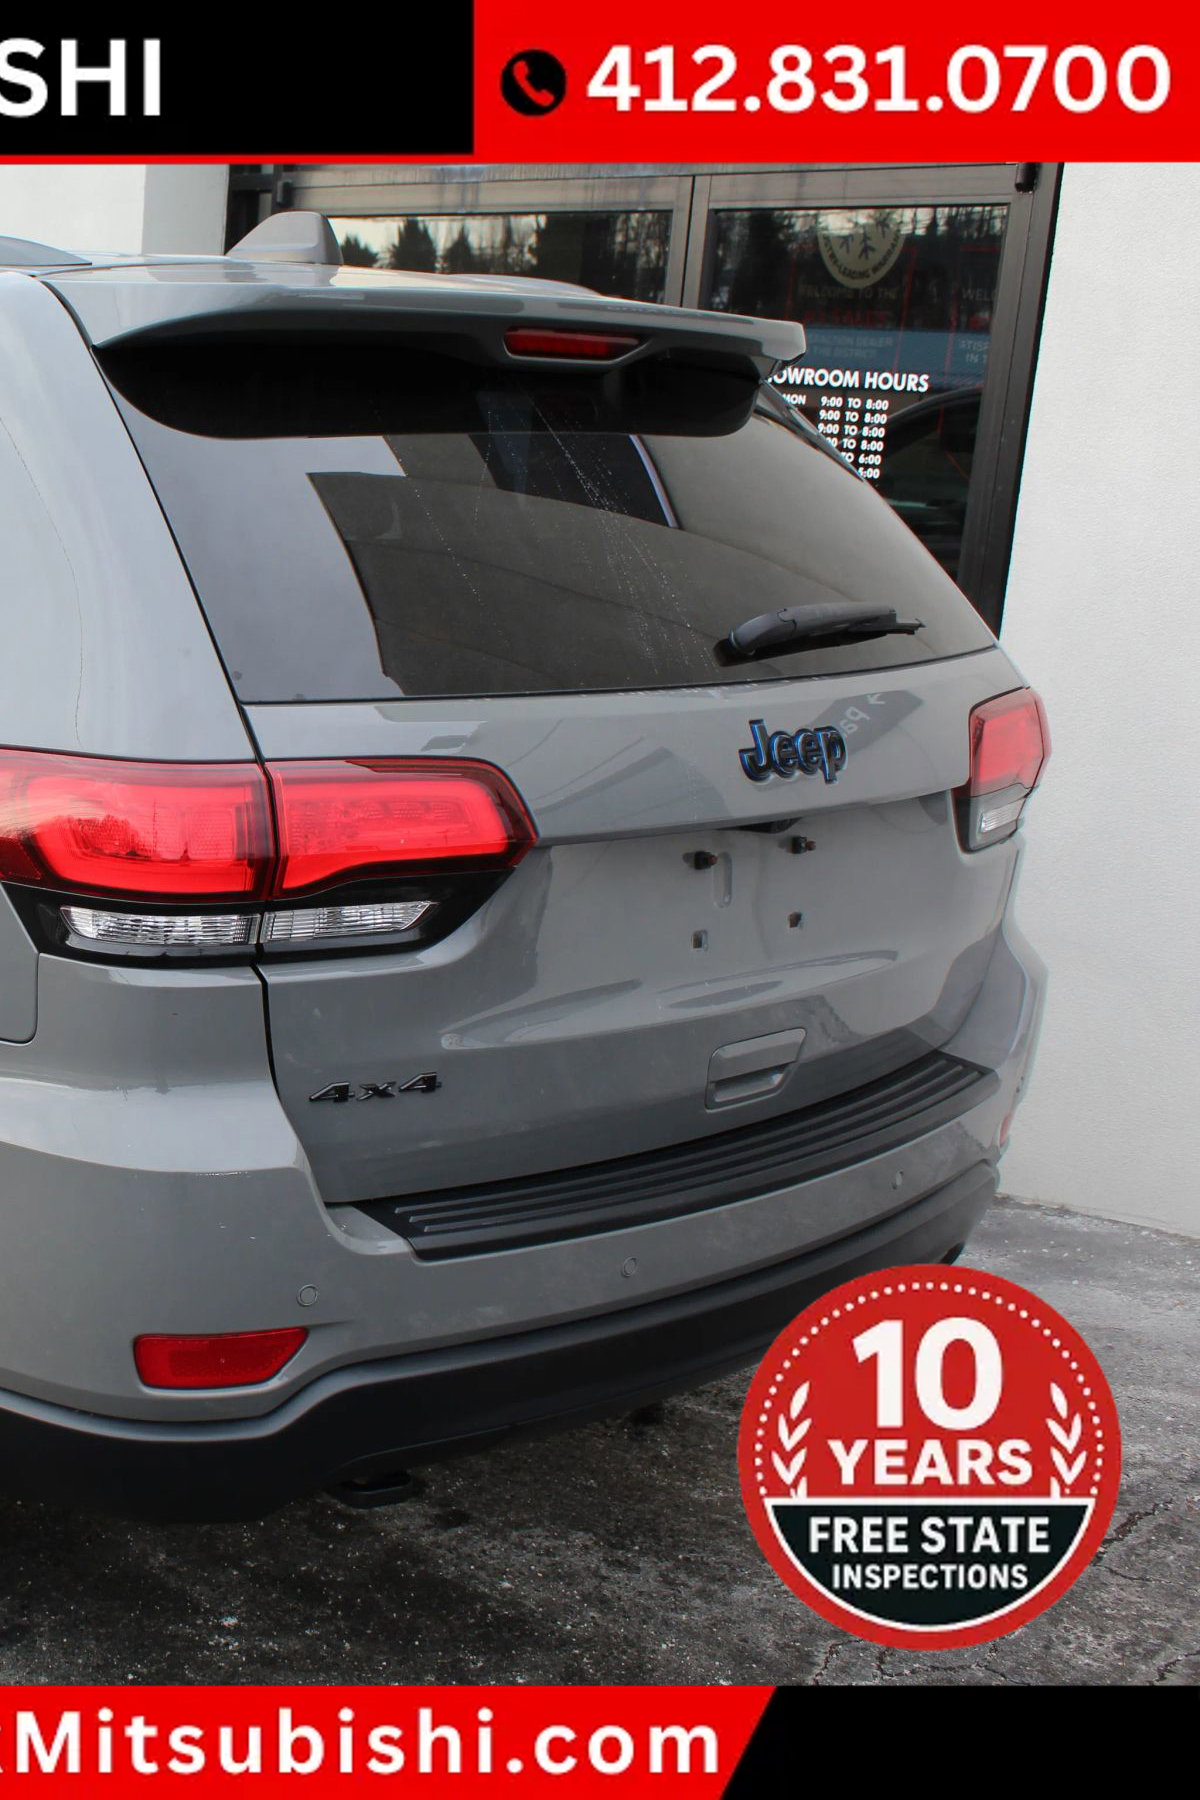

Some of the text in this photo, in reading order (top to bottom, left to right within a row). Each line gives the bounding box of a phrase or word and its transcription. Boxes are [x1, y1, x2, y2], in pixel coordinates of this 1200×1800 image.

[768, 366, 930, 393] OWROOM HOURS
[820, 396, 843, 408] 9:00
[847, 397, 862, 409] TO
[865, 399, 889, 411] 8:00
[819, 409, 888, 424] 9:00 TO 8:00
[817, 423, 886, 438] 9:00 TO 8:00
[842, 438, 857, 449] TO
[860, 440, 884, 452] 8:00
[858, 453, 882, 466] 6:00
[738, 718, 849, 784] Jeep
[308, 1071, 442, 1102] 4x4
